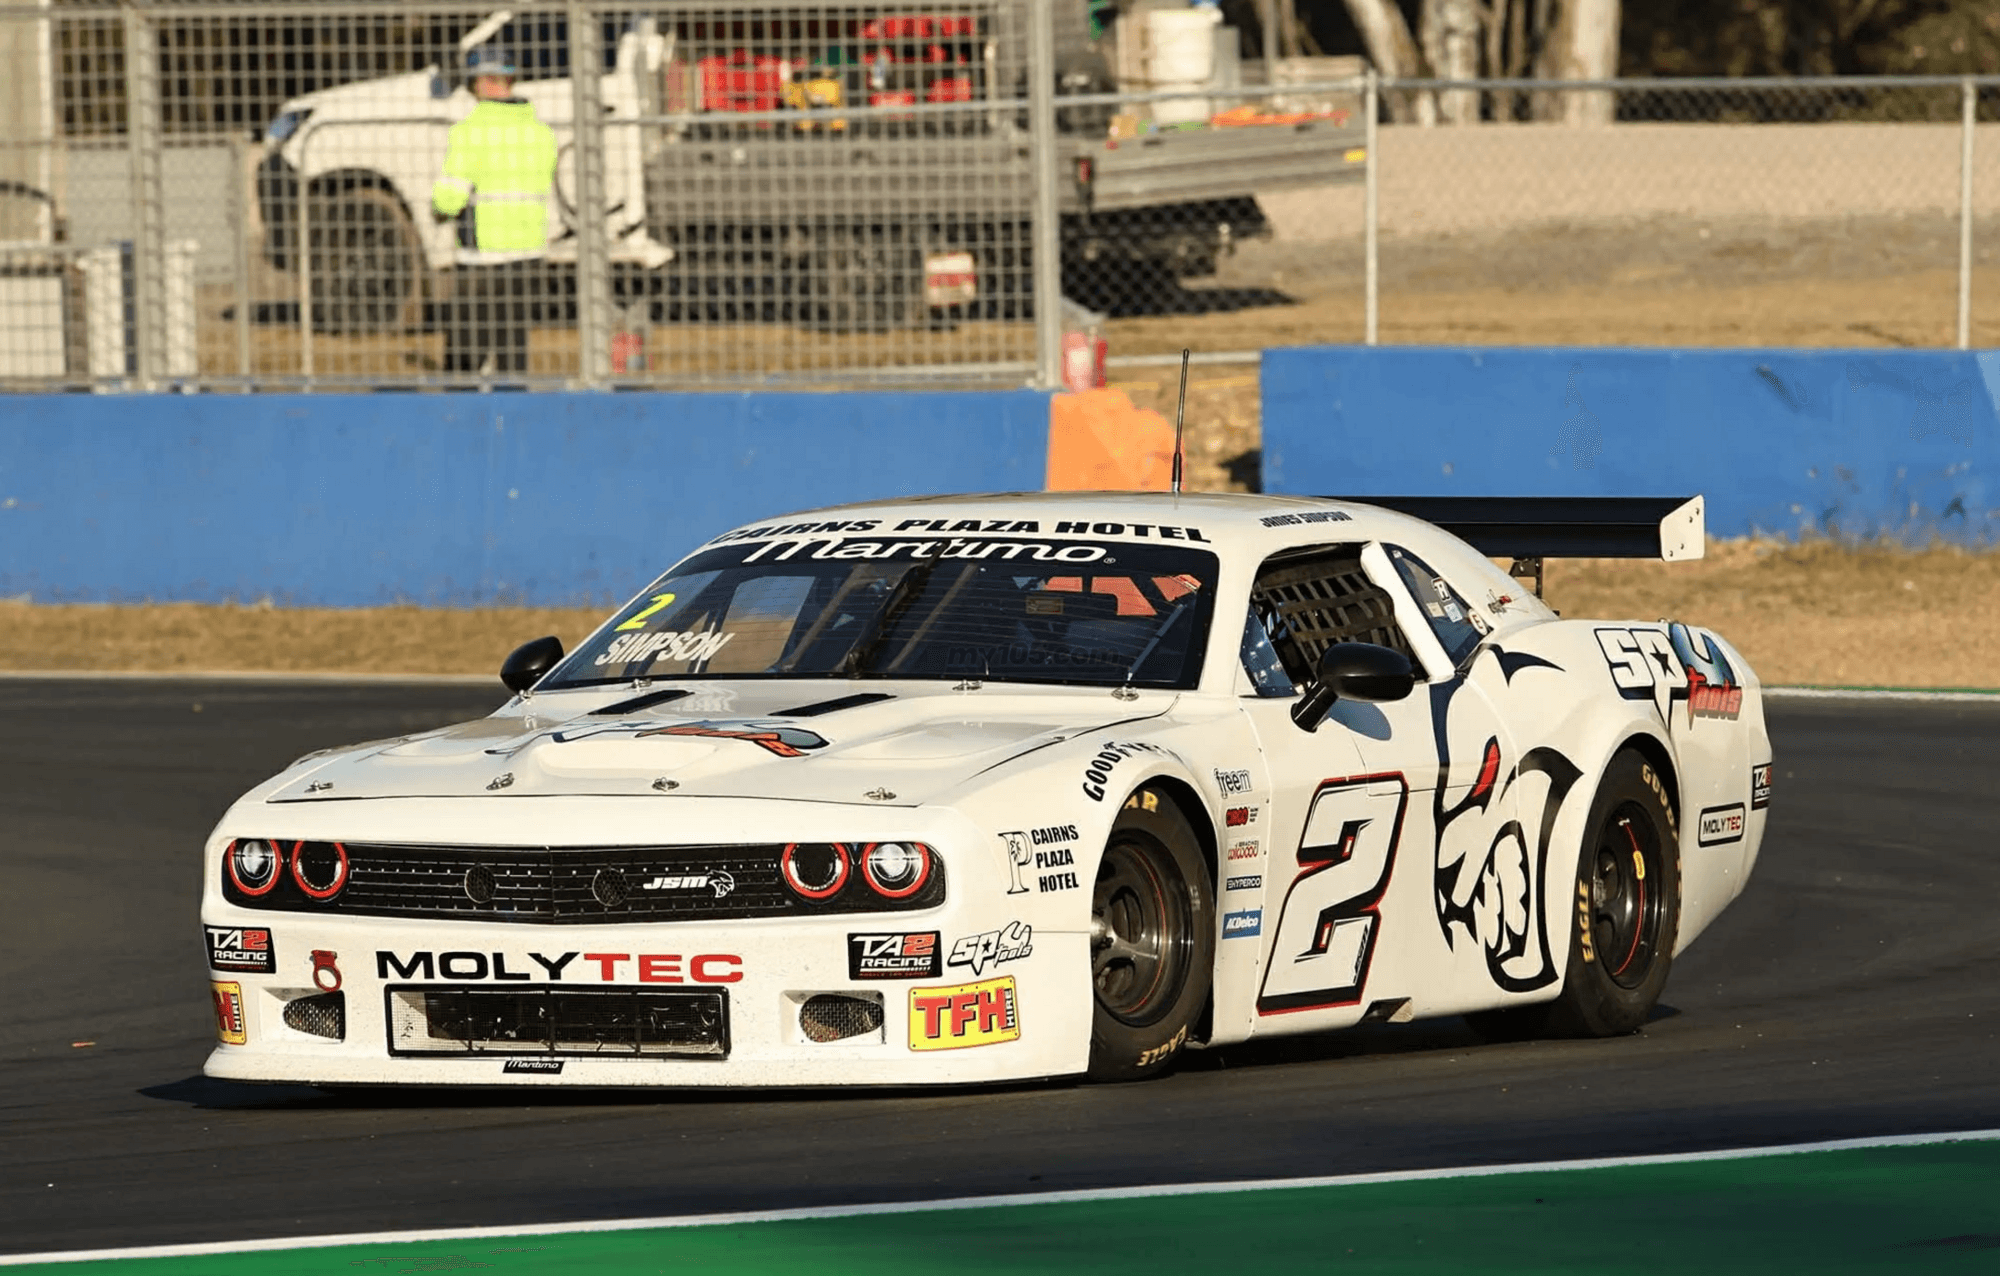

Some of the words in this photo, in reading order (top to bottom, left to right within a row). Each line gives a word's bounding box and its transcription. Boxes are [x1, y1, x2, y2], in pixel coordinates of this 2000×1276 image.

[1259, 514, 1302, 527] JAMES
[1296, 511, 1353, 523] SIMPSON
[708, 519, 883, 546] CAIRNS
[893, 519, 1039, 533] PLAZA
[1054, 521, 1212, 544] HOTEL
[614, 593, 676, 632] 2
[594, 631, 736, 666] SIMPSON
[1213, 769, 1252, 800] freem
[1031, 824, 1080, 846] CAIRNS
[1702, 815, 1742, 834] MOLYTEC
[1035, 849, 1075, 869] PLAZA
[1038, 872, 1080, 893] HOTEL
[1231, 877, 1261, 889] HYPERCO
[1256, 771, 1408, 1016] 2
[206, 928, 268, 950] TA2
[852, 933, 936, 957] TA2
[214, 951, 268, 961] RACING
[376, 950, 744, 983] MOLYTEC
[860, 956, 932, 968] RACING
[914, 987, 1007, 1039] TFH
